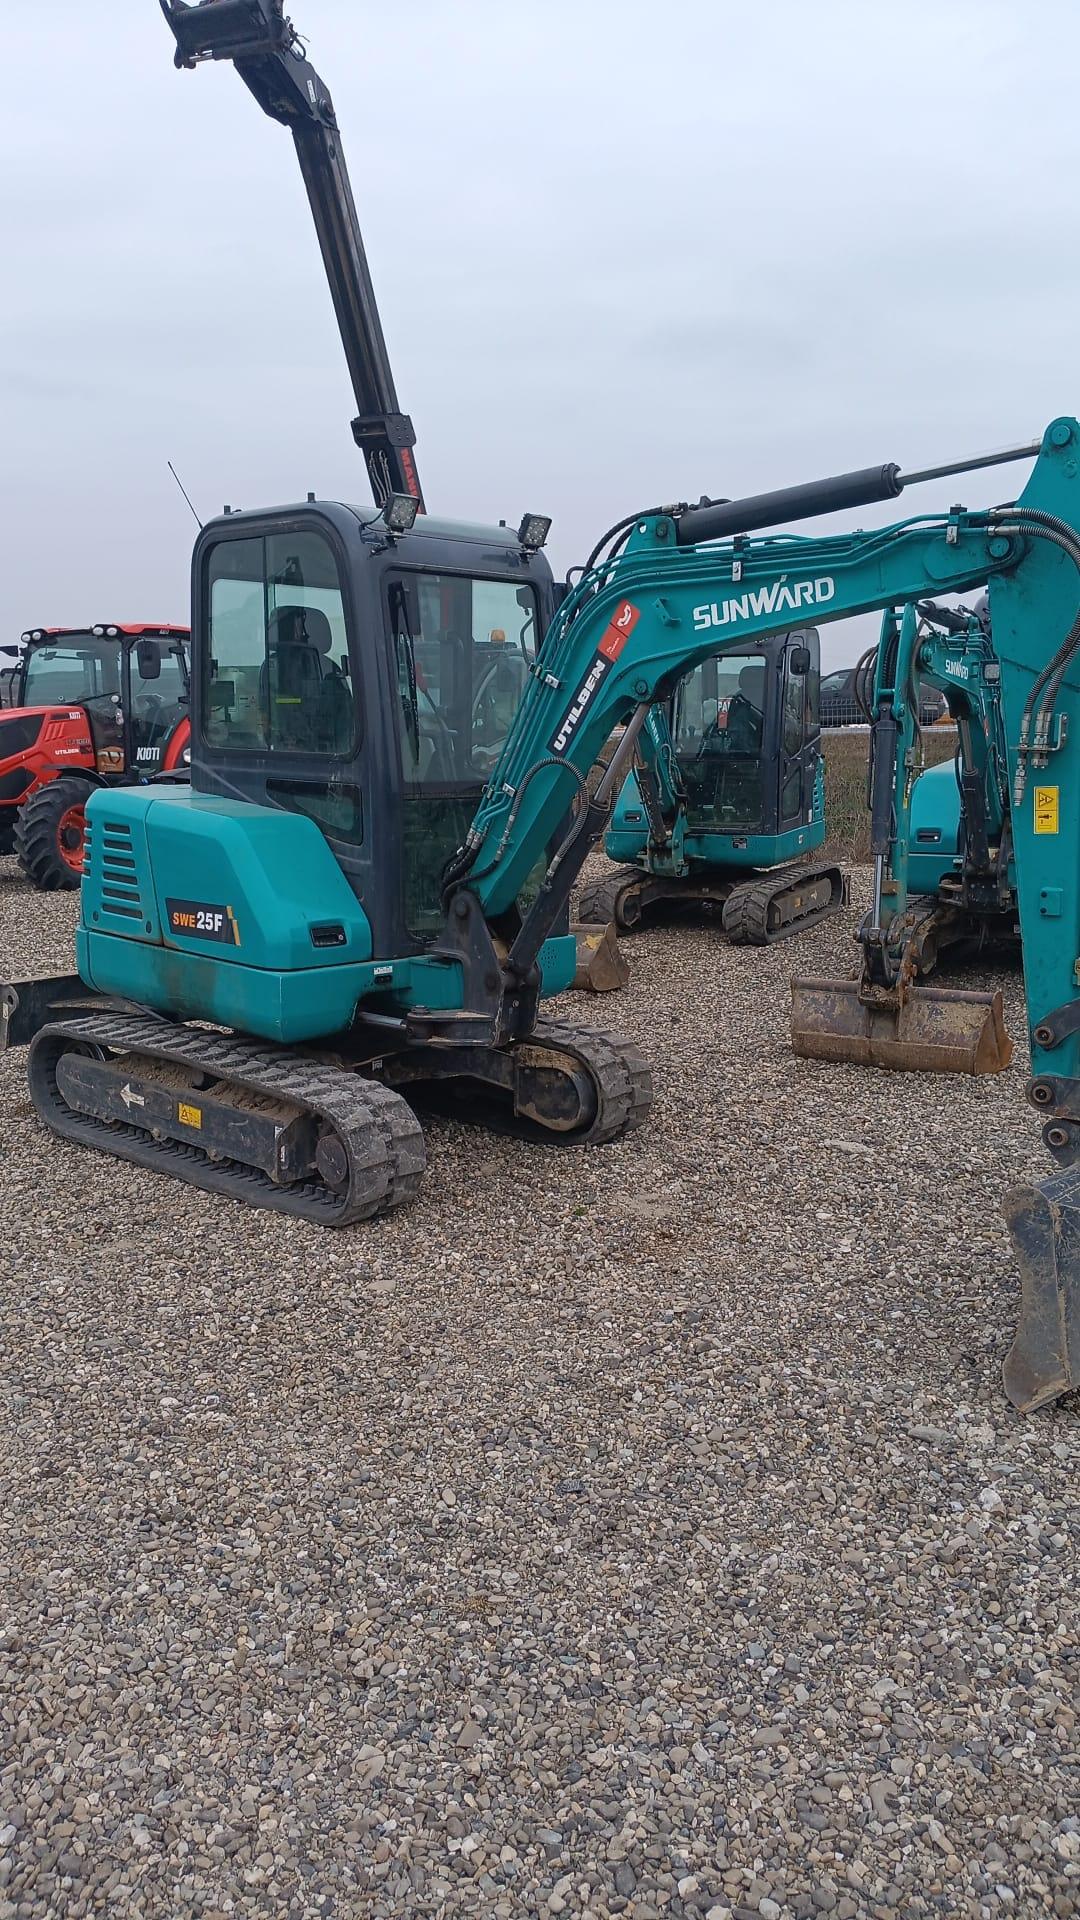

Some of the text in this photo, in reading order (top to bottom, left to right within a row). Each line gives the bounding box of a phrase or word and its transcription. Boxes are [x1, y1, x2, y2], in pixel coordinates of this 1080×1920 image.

[692, 574, 835, 631] SUNWARD
[553, 659, 606, 751] UTILBEN
[136, 747, 160, 761] KIOTI
